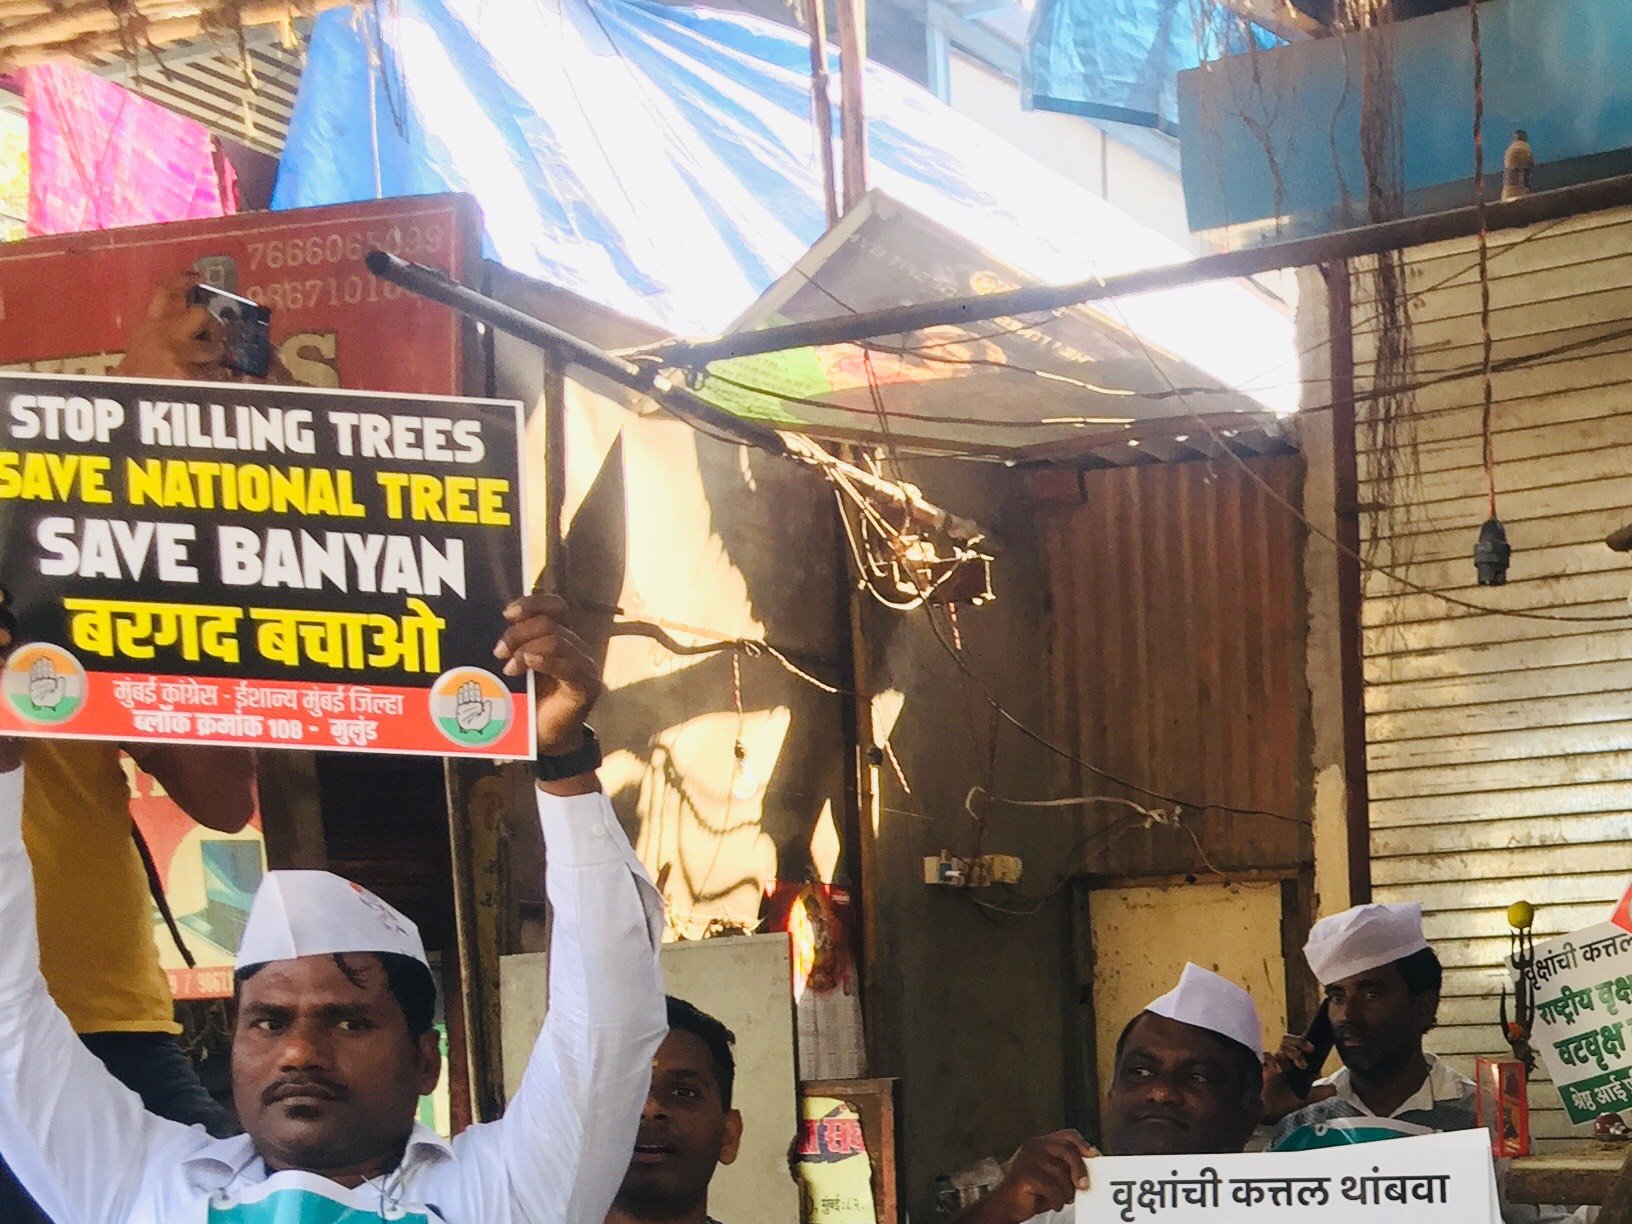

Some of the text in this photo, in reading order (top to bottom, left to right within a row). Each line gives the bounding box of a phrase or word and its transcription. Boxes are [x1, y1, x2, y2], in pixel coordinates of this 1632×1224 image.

[10, 395, 485, 463] STOP KILLING TREES
[0, 452, 511, 526] SAVE NATIONAL TREE
[37, 517, 466, 599] SAVE BANYAN
[64, 597, 445, 674] बरगद बचाओ
[112, 676, 404, 717] मुंबई कांग्रेस ईशान्य मुंबई जिल्हा
[132, 704, 378, 746] ब्लॉक क्रमांक 108 मुलुंड
[1535, 985, 1594, 1025] राष्ट्रीय
[1553, 1022, 1625, 1071] वटवृक्ष
[1595, 1075, 1628, 1104] आई
[1110, 1167, 1450, 1222] वृक्षांची कत्तल थांबवा
